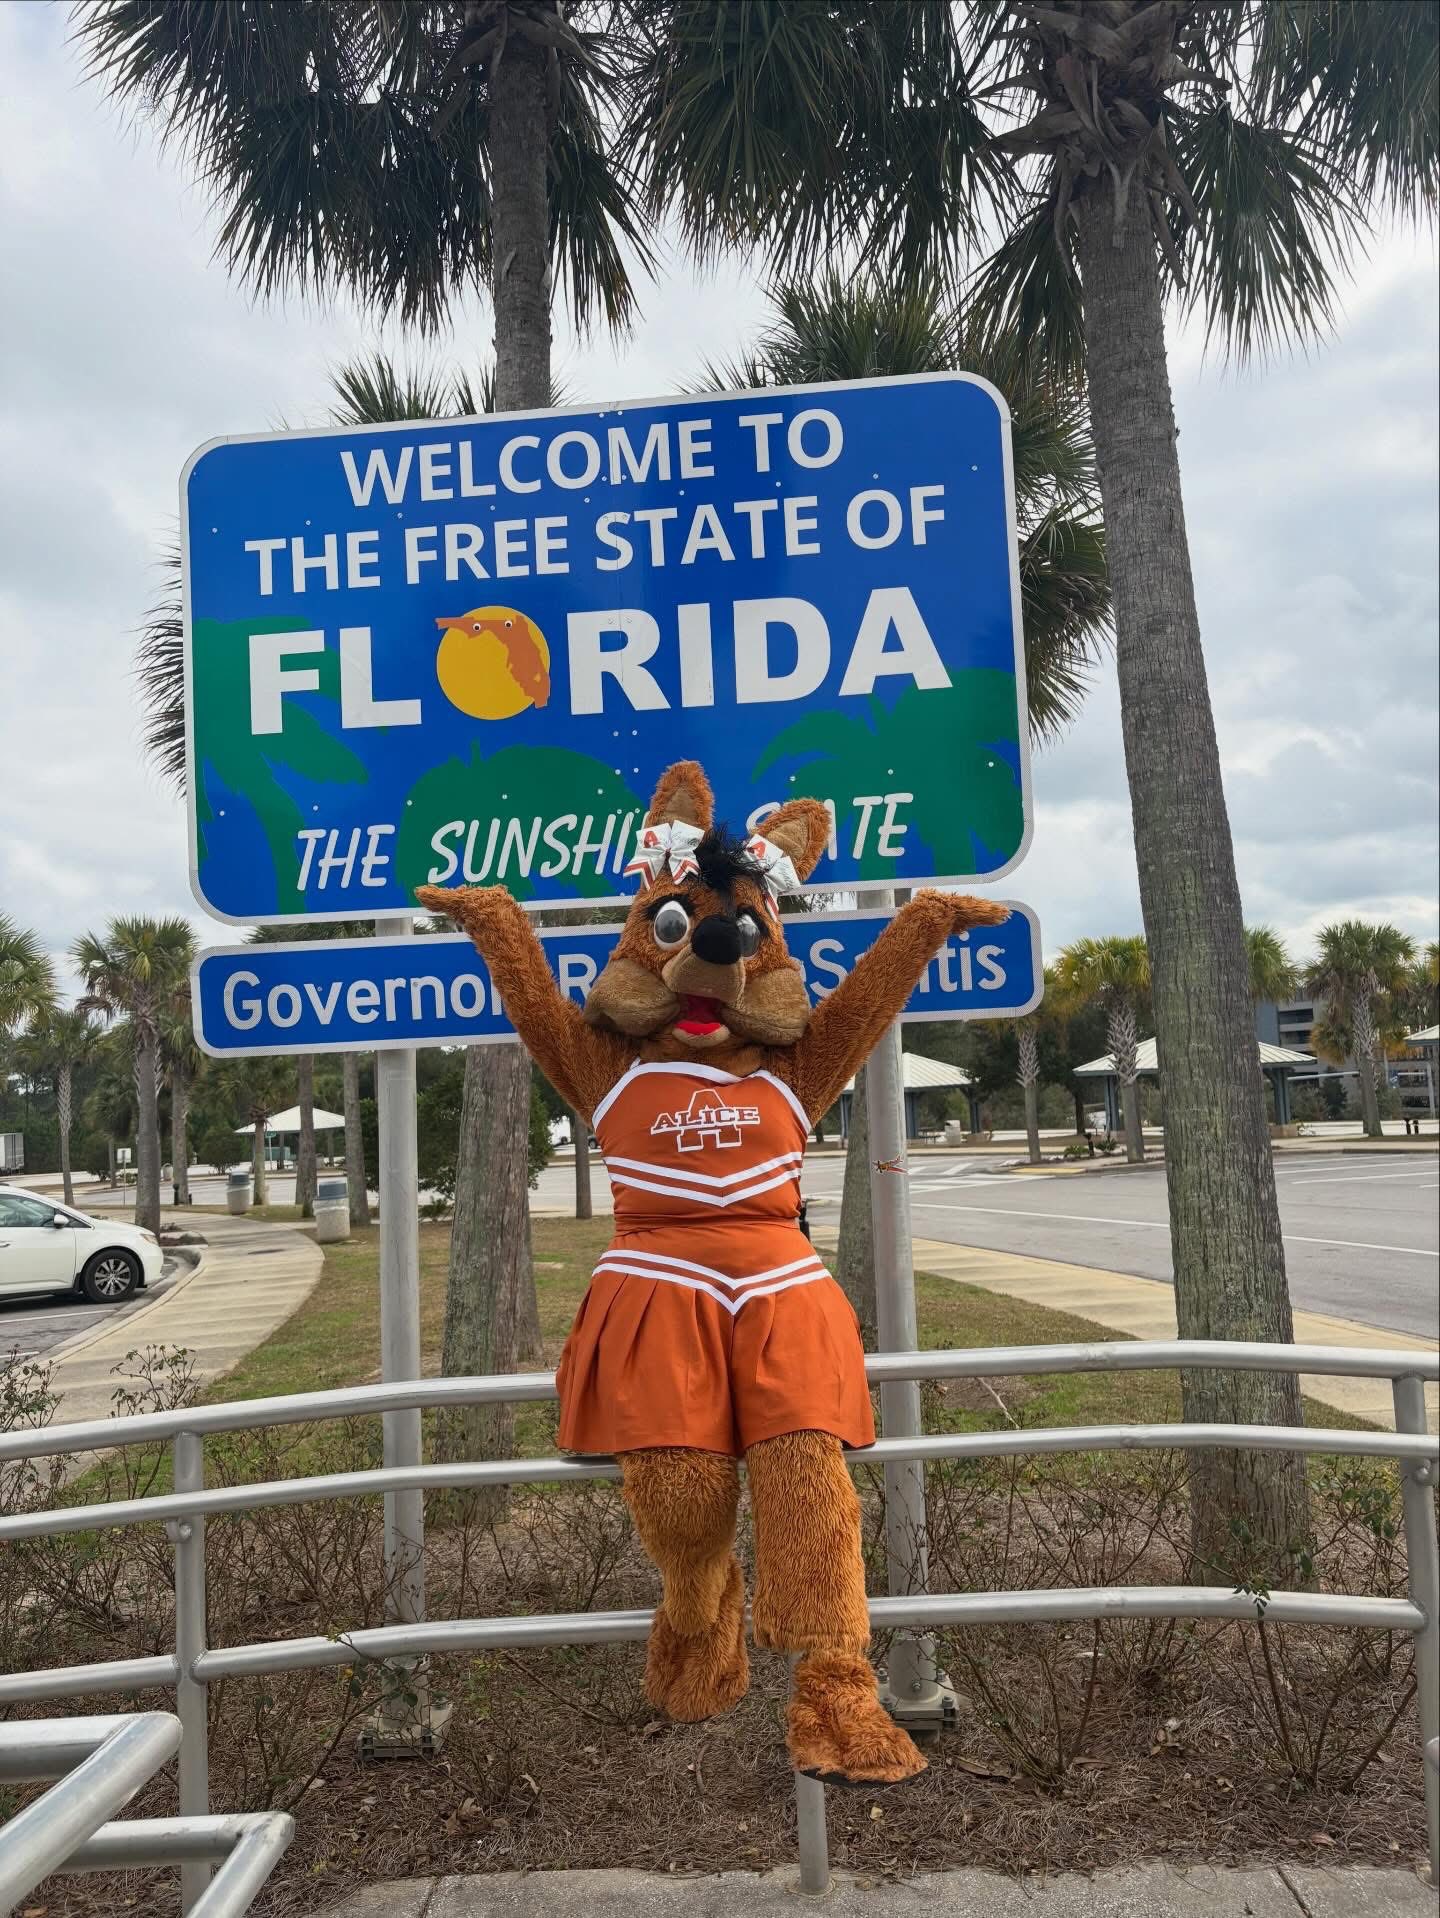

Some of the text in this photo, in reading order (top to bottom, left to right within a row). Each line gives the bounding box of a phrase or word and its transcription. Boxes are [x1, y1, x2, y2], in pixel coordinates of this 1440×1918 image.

[340, 409, 844, 507] WELCOME TO
[244, 485, 946, 597] THE FREE STATE OF
[296, 824, 396, 891] THE
[427, 811, 651, 884] SUNSHI
[650, 1106, 760, 1135] ALICE
